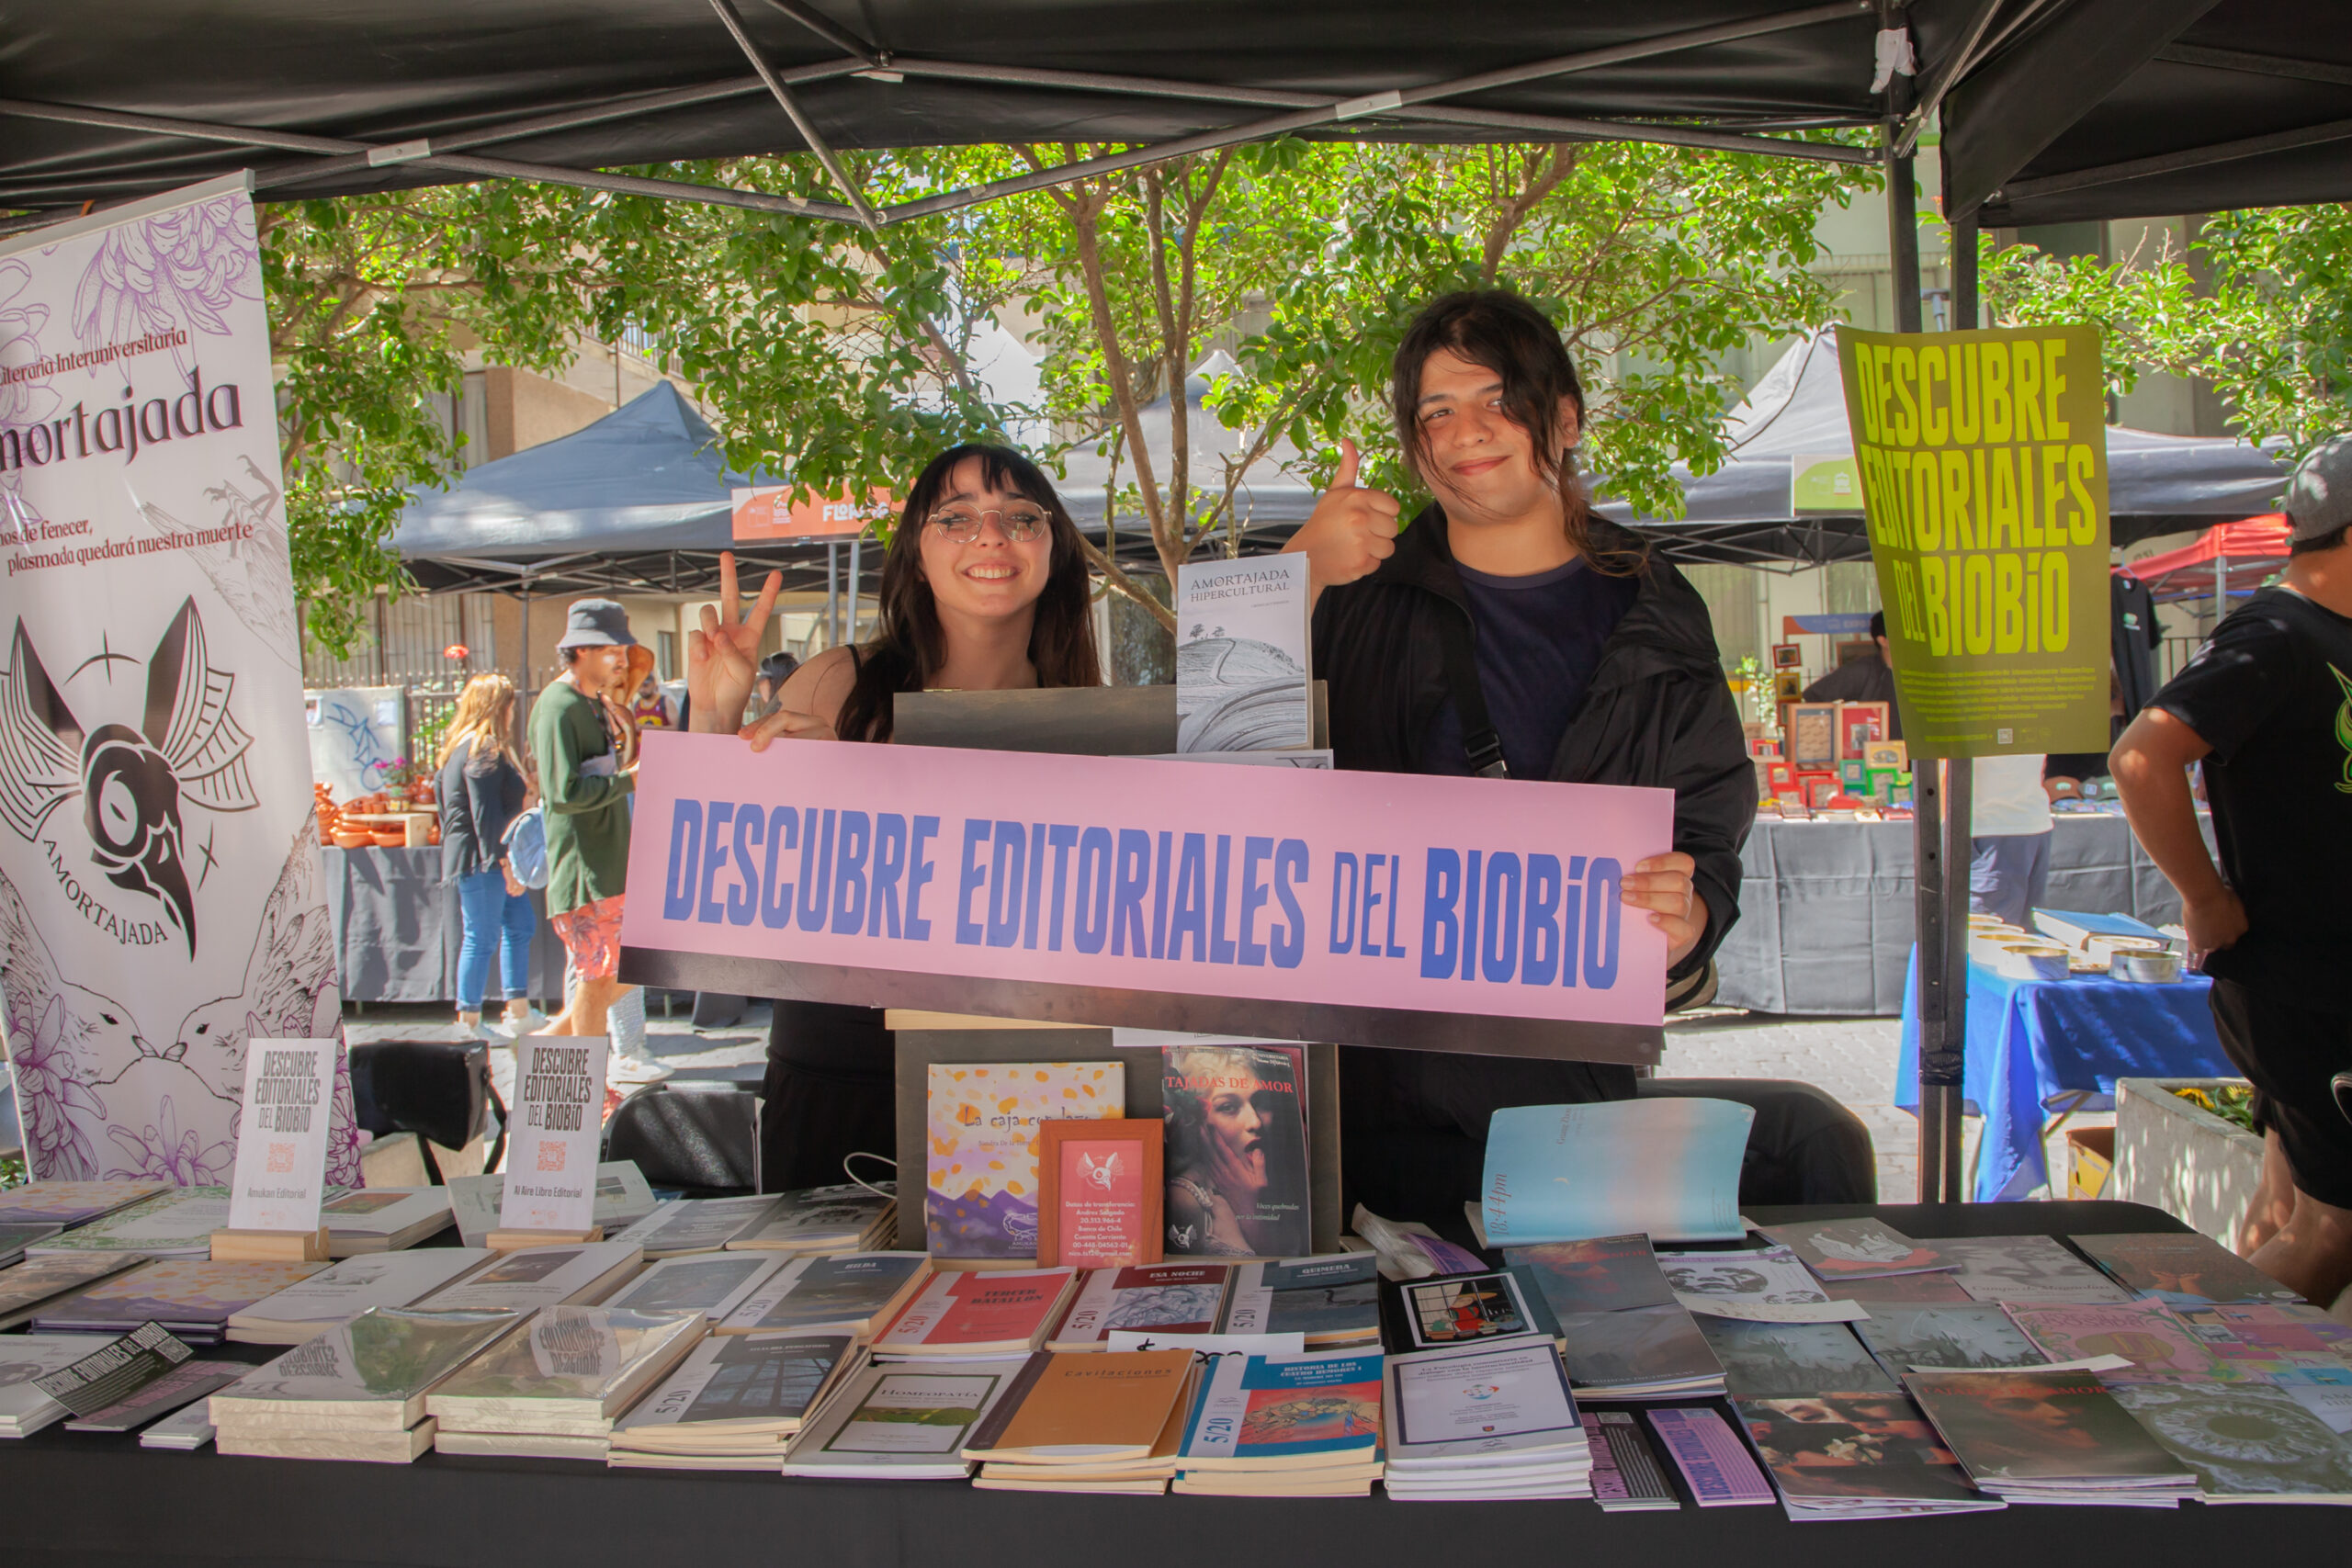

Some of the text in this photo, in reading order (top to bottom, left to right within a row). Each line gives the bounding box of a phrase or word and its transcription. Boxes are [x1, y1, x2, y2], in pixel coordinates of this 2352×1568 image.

[55, 326, 187, 373] Interuniversitaria
[1854, 338, 2070, 448] DESCUBRE
[1860, 444, 2097, 552] EDITORIALES
[21, 524, 38, 542] de
[40, 519, 93, 540] fenecer,
[7, 521, 254, 577] plasmada quedará nuestra muerte
[1191, 569, 1290, 591] AMORTAJADA
[1191, 581, 1290, 603] HIPERCULTURAL
[1893, 559, 1927, 642] DEL
[42, 837, 170, 946] AMORTAJADA
[662, 798, 941, 942] DESCUBRE
[955, 818, 1310, 970] EDITORIALES
[1329, 851, 1407, 958] DEL
[263, 1050, 319, 1077] DESCUBRE
[532, 1047, 589, 1076] DESCUBRE
[254, 1077, 321, 1105] EDITORIALES
[524, 1075, 593, 1103] EDITORIALES
[1165, 1076, 1294, 1093] TAJADAS DE AMOR
[258, 1107, 274, 1129] DEL
[527, 1104, 543, 1126] DEL
[964, 1106, 982, 1127] La
[990, 1111, 1021, 1133] caja
[277, 1188, 307, 1199] Editorial
[521, 1186, 534, 1196] Aire
[535, 1186, 552, 1197] Libro
[553, 1187, 582, 1199] Editorial
[1302, 1264, 1351, 1274] QUIMERA
[984, 1289, 1037, 1297] TERCER
[898, 1315, 930, 1335] 5/20
[1071, 1310, 1099, 1330] 5/20
[1233, 1308, 1257, 1328] 5/20
[1064, 1368, 1172, 1377] Cavilaciones
[1204, 1417, 1234, 1444] 5/20
